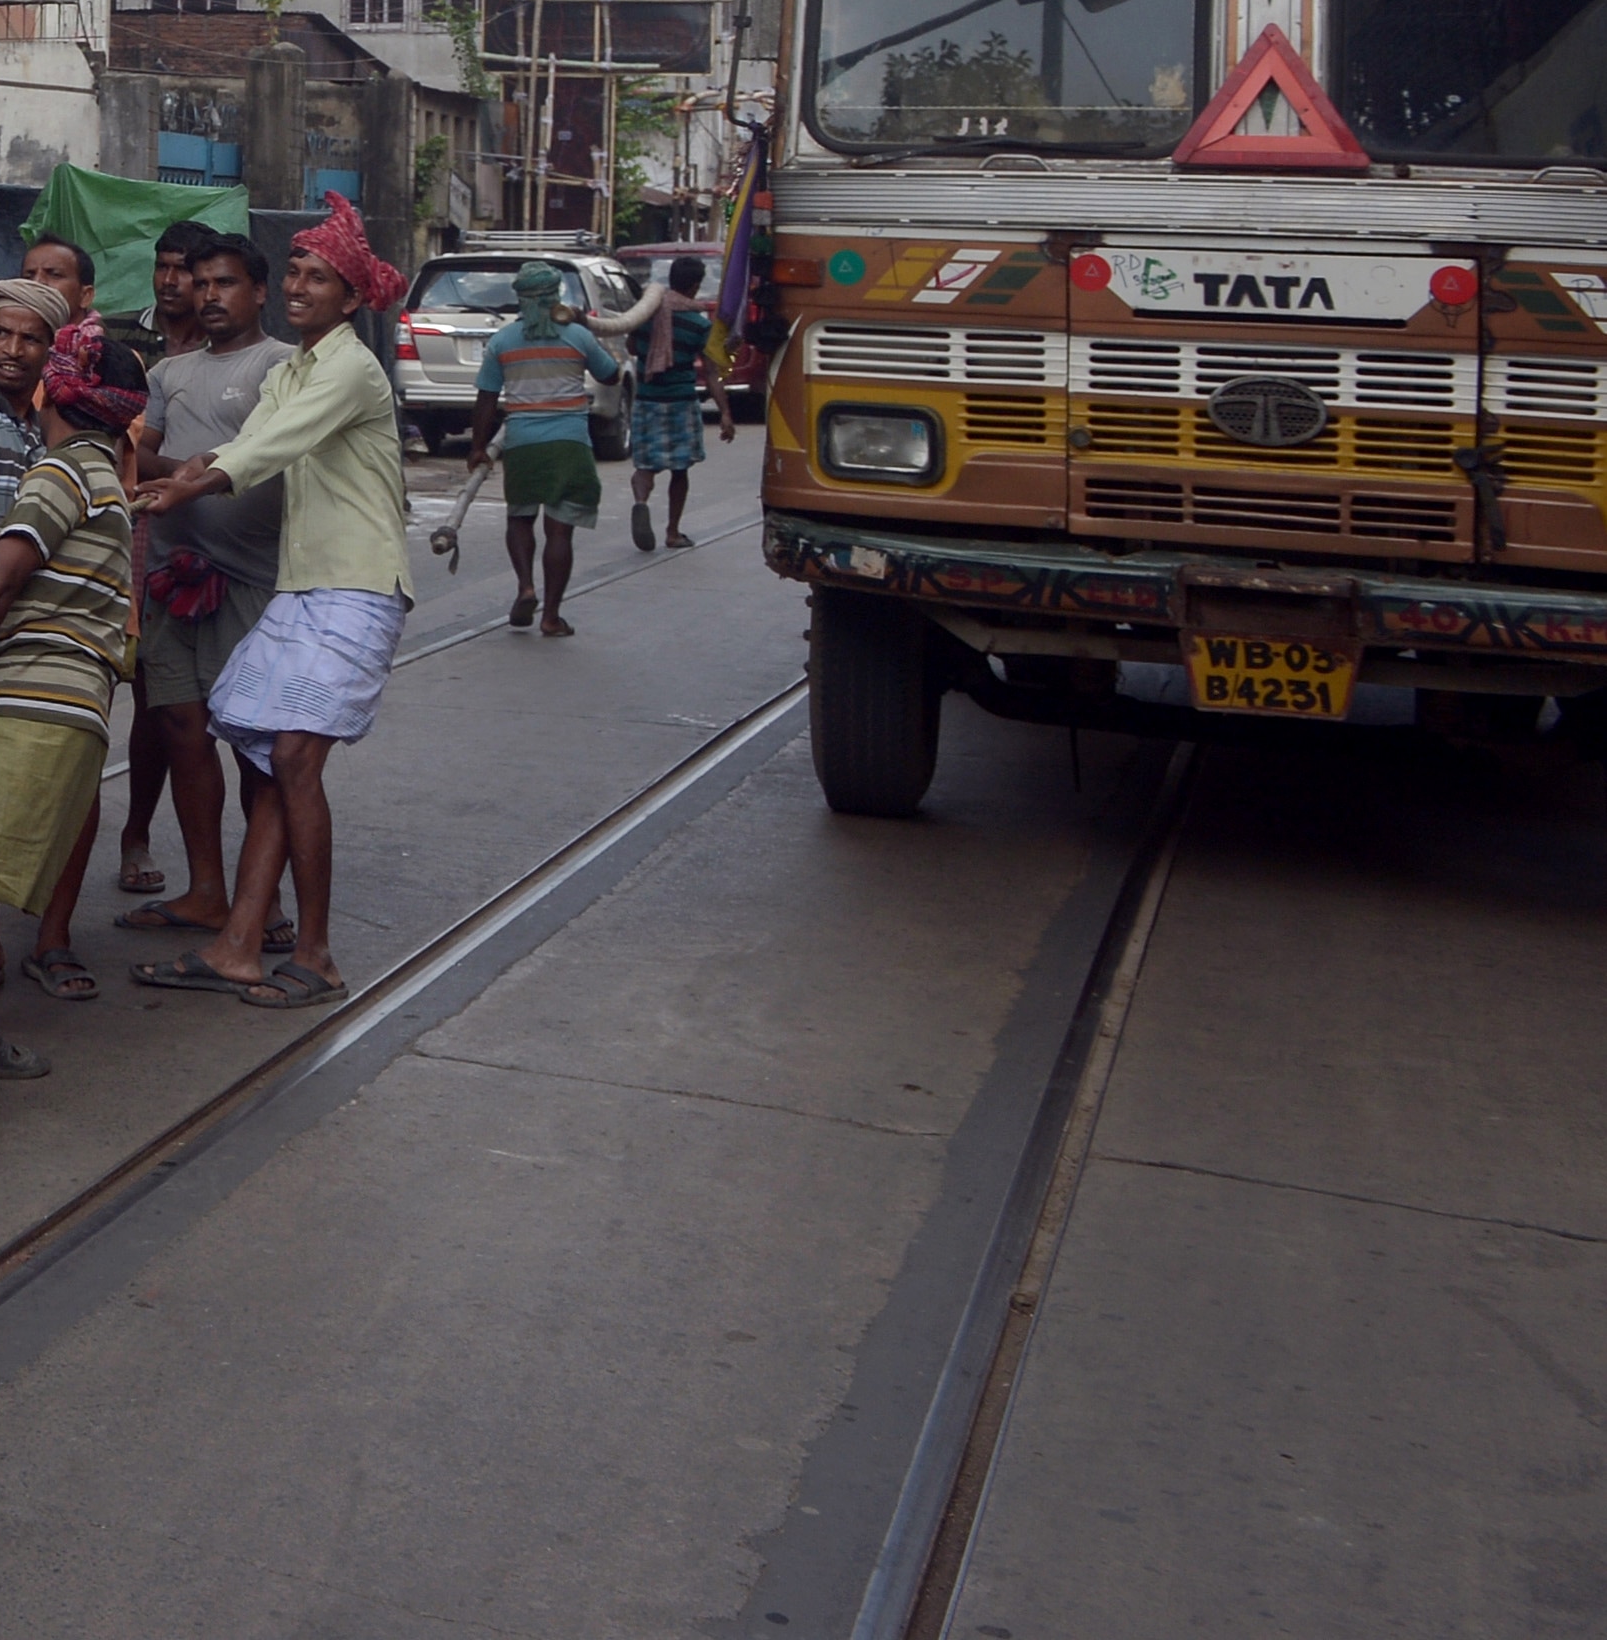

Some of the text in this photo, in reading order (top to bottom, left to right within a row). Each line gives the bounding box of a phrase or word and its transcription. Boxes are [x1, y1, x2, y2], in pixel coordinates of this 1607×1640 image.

[1193, 272, 1336, 312] TATA
[1398, 601, 1459, 632] 40
[1206, 639, 1338, 674] WB-03
